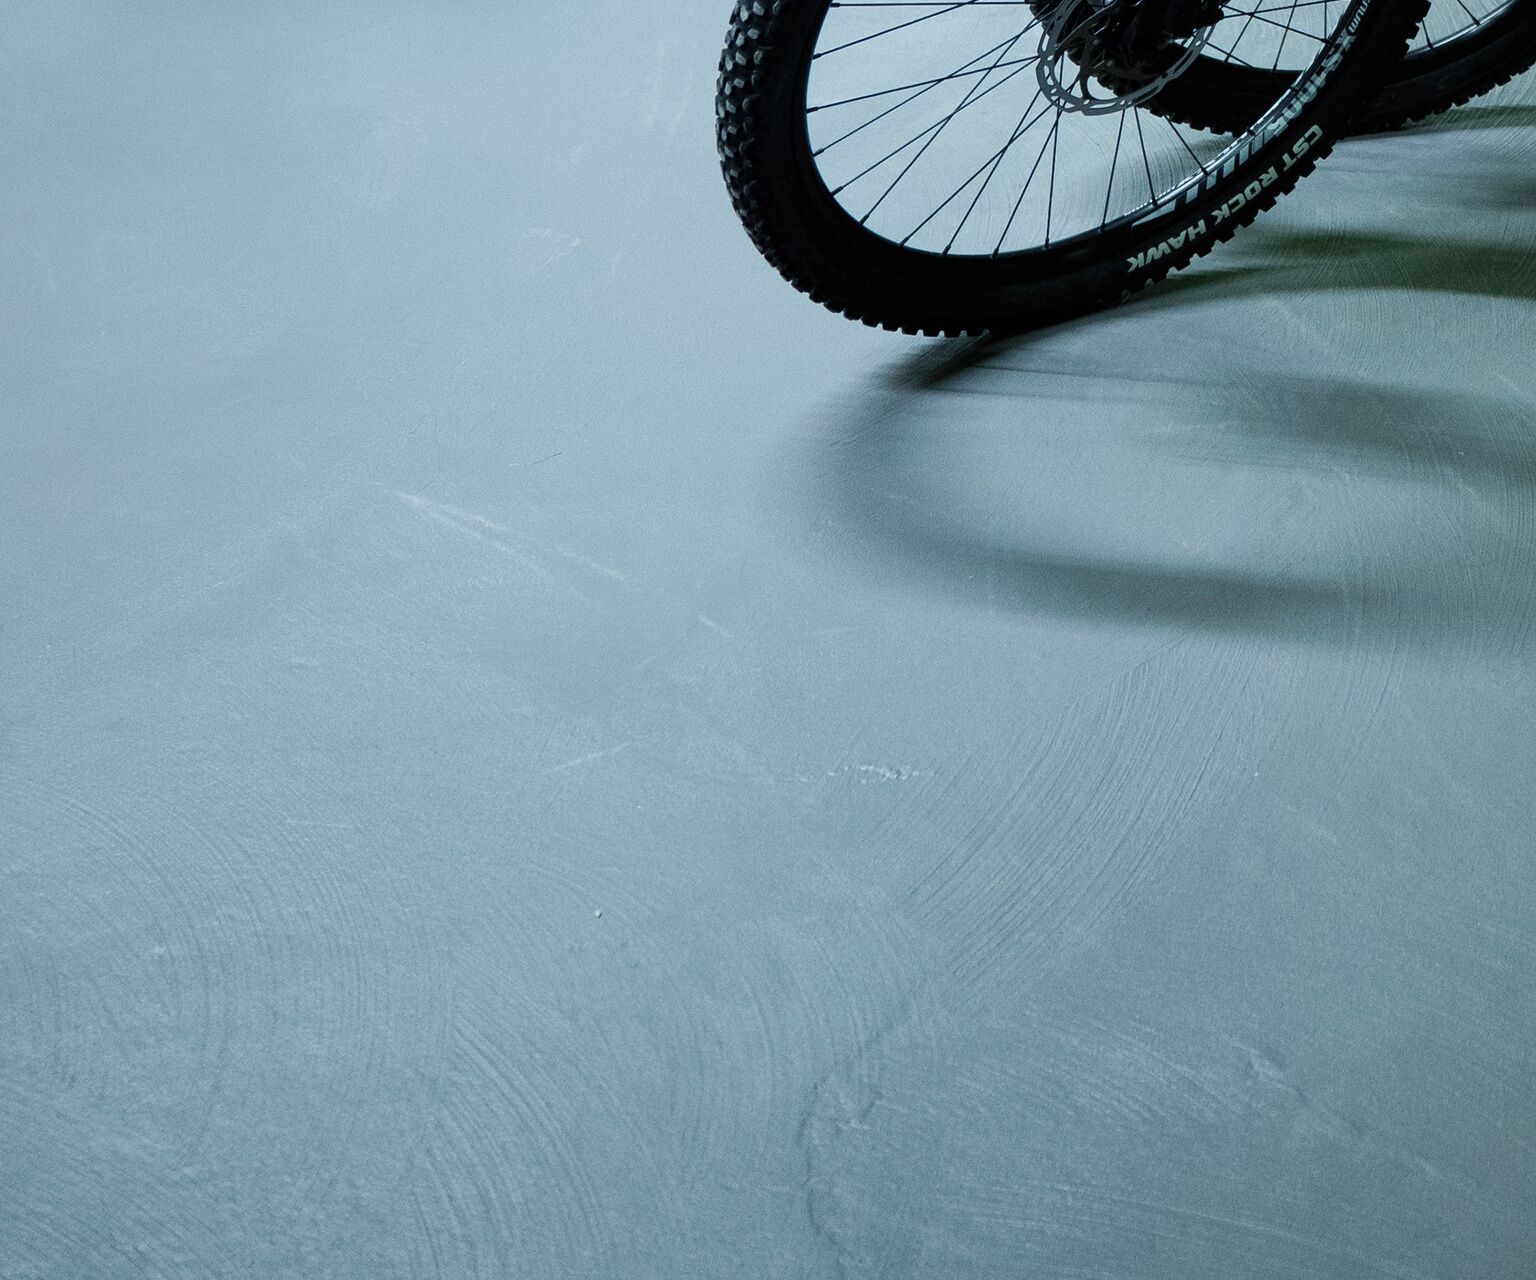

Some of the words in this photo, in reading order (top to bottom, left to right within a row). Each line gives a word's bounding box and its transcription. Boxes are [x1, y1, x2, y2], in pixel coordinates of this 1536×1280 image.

[1283, 124, 1324, 171] CST
[1212, 165, 1280, 225] ROCK
[1126, 219, 1206, 272] HAWK
